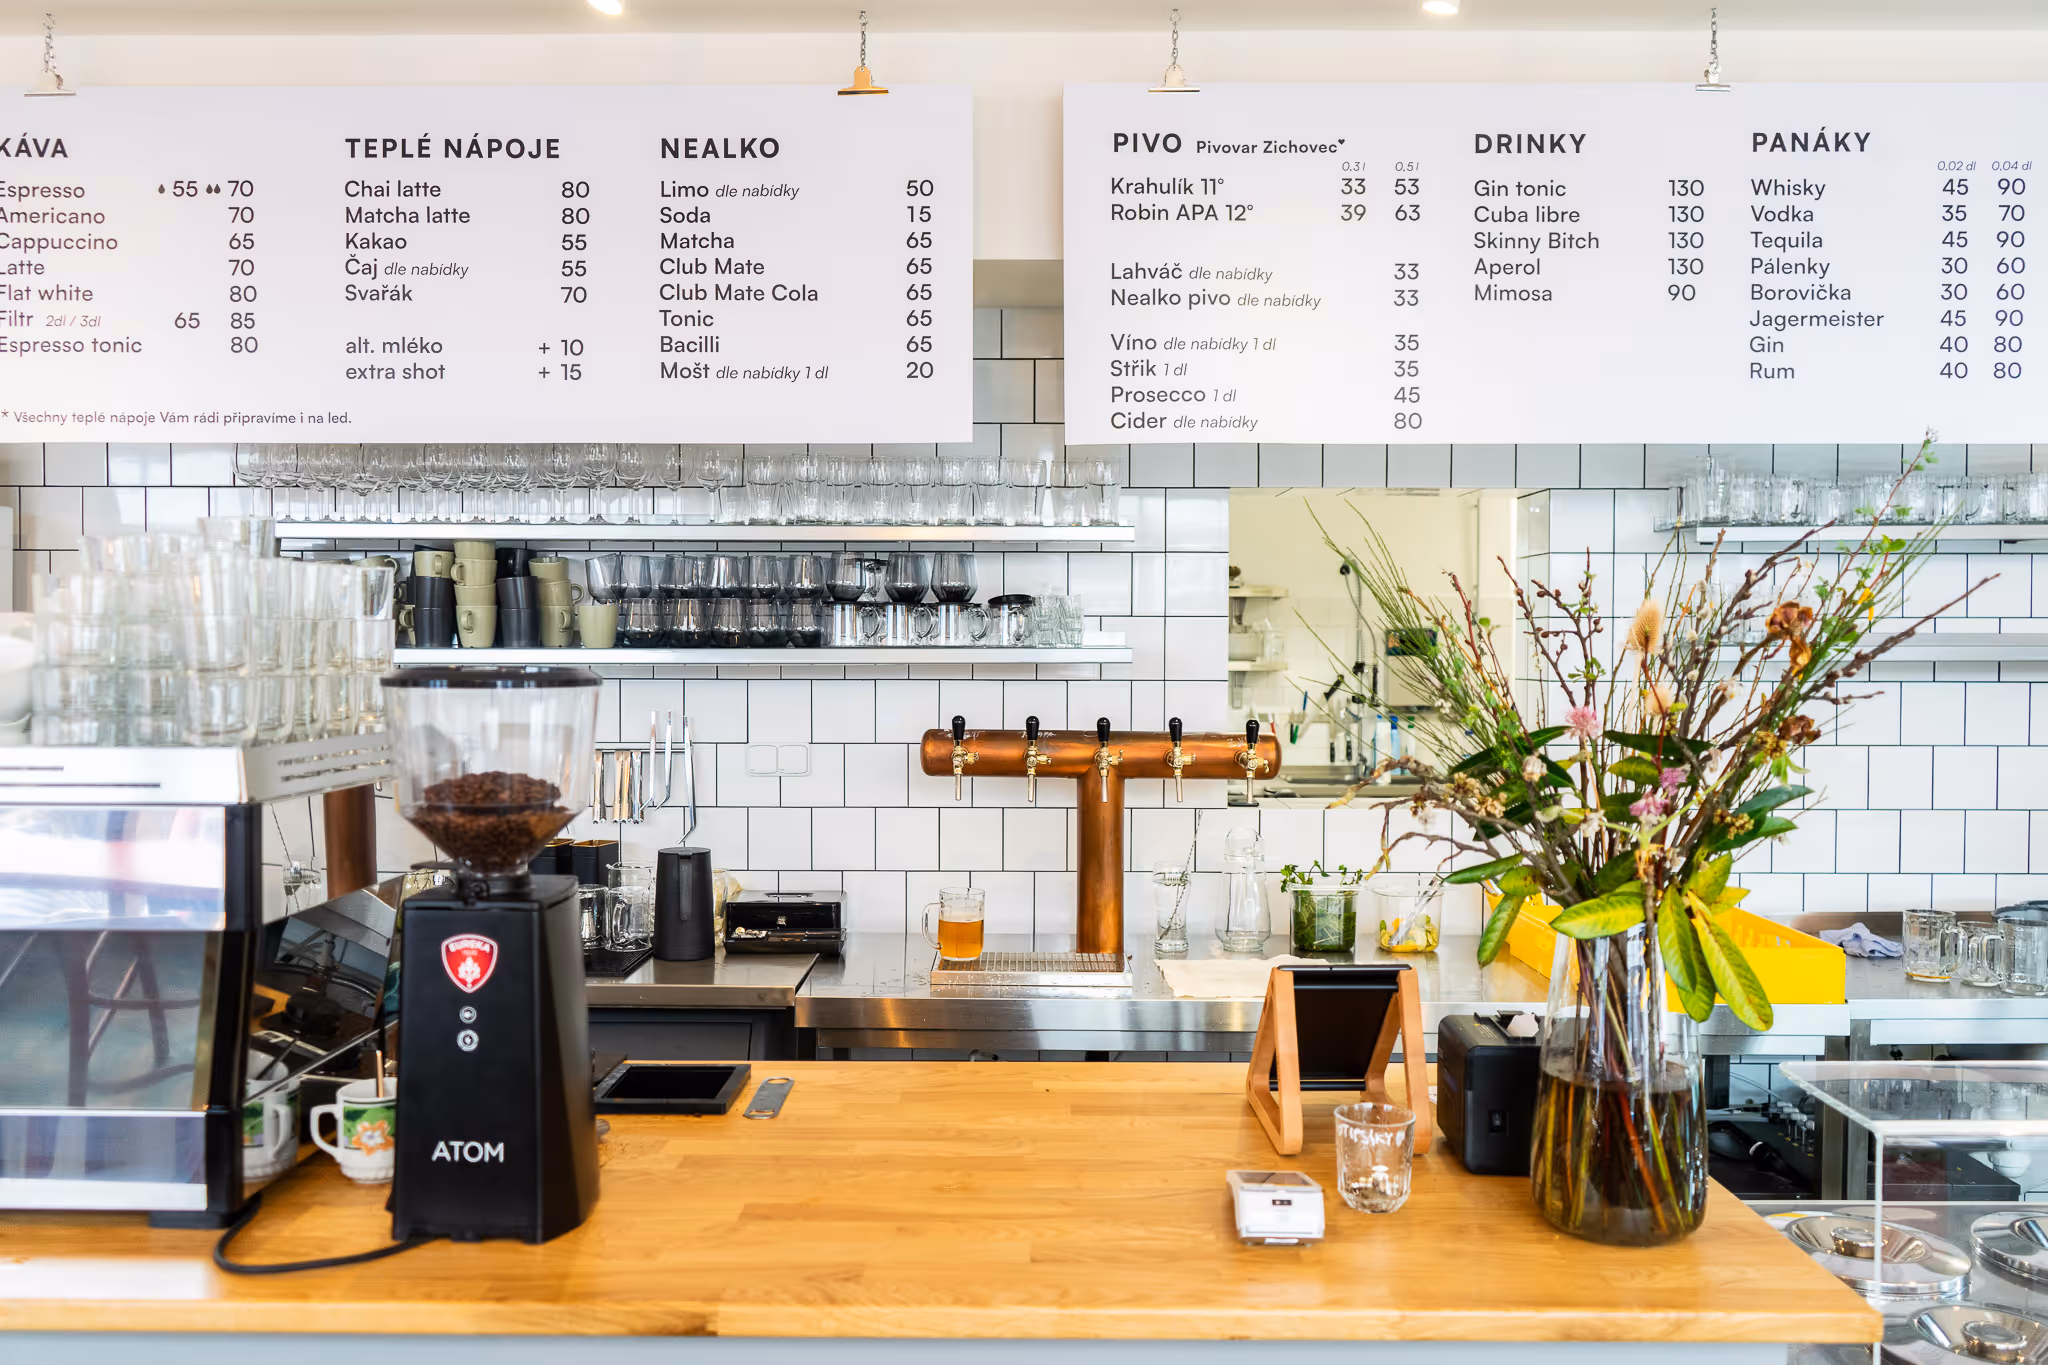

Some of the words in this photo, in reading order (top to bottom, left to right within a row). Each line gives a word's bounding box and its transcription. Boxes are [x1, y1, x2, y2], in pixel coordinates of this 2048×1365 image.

[345, 133, 431, 158] TEPLÉ
[444, 133, 559, 159] NÁPOJE
[1114, 133, 1181, 153] PIVO
[1197, 141, 1257, 153] Pivovar
[1263, 140, 1337, 153] Zichovec
[1475, 134, 1586, 154] DRINKY
[1753, 126, 1870, 152] PANÁKY
[661, 138, 779, 159] NEALKO
[173, 181, 198, 197] 55
[227, 180, 254, 197] 70
[345, 180, 390, 197] Chai
[398, 180, 441, 197] latte
[562, 181, 589, 198] 80
[661, 181, 709, 197] Limo
[716, 184, 737, 197] dle
[742, 184, 800, 200] nabídky
[907, 180, 934, 196] 50
[1112, 177, 1193, 194] Krahulík
[1341, 178, 1366, 195] 33
[1394, 178, 1419, 195] 53
[1474, 180, 1508, 196] Gin
[1516, 180, 1566, 196] tonic
[1669, 179, 1704, 196] 130
[1751, 179, 1826, 200] Whisky
[1942, 179, 1968, 195] 45
[1998, 178, 2025, 195] 90
[228, 206, 254, 223] 70
[346, 206, 419, 223] Matcha
[427, 206, 470, 223] latte
[562, 208, 590, 224] 80
[660, 206, 710, 223] Soda
[907, 206, 931, 222] 15
[1112, 203, 1168, 220] Robin
[1176, 204, 1219, 221] APA
[1341, 204, 1366, 221] 39
[1395, 204, 1420, 221] 63
[1474, 206, 1528, 222] Cuba
[1536, 206, 1580, 223] libre
[1668, 206, 1704, 222] 130
[1751, 205, 1813, 222] Vodka
[1942, 204, 1967, 221] 35
[1999, 205, 2025, 221] 70
[229, 233, 254, 250] 65
[346, 232, 407, 249] Kakao
[562, 234, 587, 251] 55
[661, 232, 734, 249] Matcha
[906, 232, 932, 249] 65
[1474, 232, 1541, 254] Skinny
[1549, 232, 1599, 249] Bitch
[1668, 232, 1704, 249] 130
[1750, 231, 1822, 253] Tequila
[1942, 231, 1968, 248] 45
[1997, 231, 2025, 248] 90
[228, 259, 254, 276] 70
[345, 254, 377, 280] Čaj
[384, 262, 406, 275] dle
[411, 263, 469, 279] nabídky
[561, 260, 586, 277] 55
[660, 258, 707, 275] Club
[715, 258, 764, 275] Mate
[907, 258, 932, 274] 65
[1112, 262, 1182, 279] Lahváč
[1189, 266, 1211, 279] dle
[1216, 267, 1273, 284] nabídky
[1394, 263, 1419, 280] 33
[1474, 258, 1540, 280] Aperol
[1668, 258, 1704, 275] 130
[1752, 257, 1830, 279] Pálenky
[1941, 257, 1968, 274] 30
[1997, 257, 2025, 274] 60
[38, 284, 93, 301] white
[230, 285, 257, 302] 80
[345, 284, 412, 301] Svařák
[561, 286, 587, 303] 70
[660, 283, 707, 300] Club
[715, 284, 764, 301] Mate
[772, 284, 818, 301] Cola
[907, 284, 932, 301] 65
[1112, 288, 1181, 306] Nealko
[1189, 289, 1230, 310] pivo
[1238, 293, 1259, 306] dle
[1264, 294, 1321, 310] nabídky
[1394, 290, 1418, 306] 33
[1475, 284, 1552, 301] Mimosa
[1668, 284, 1696, 301] 90
[1751, 283, 1851, 300] Borovička
[1941, 283, 1967, 300] 30
[1996, 283, 2025, 300] 60
[46, 315, 66, 326] 2dl
[80, 316, 101, 327] 3dl
[174, 312, 200, 329] 65
[231, 312, 255, 329] 85
[659, 310, 714, 327] Tonic
[907, 310, 932, 327] 65
[1750, 310, 1884, 332] Jagermeister
[1940, 310, 1966, 326] 45
[1995, 310, 2023, 326] 90
[0, 336, 84, 357] Espresso
[91, 336, 142, 353] tonic
[231, 336, 258, 353] 80
[346, 337, 374, 353] alt.
[383, 337, 442, 353] mléko
[561, 339, 584, 356] 10
[661, 336, 719, 353] Bacilli
[907, 336, 932, 352] 65
[1110, 334, 1157, 350] Víno
[1164, 337, 1185, 350] dle
[1191, 337, 1248, 353] nabídky
[1394, 334, 1419, 351] 35
[1750, 336, 1784, 353] Gin
[1940, 336, 1968, 352] 40
[1994, 336, 2022, 352] 80
[346, 364, 395, 379] extra
[402, 362, 445, 379] shot
[561, 364, 581, 380] 15
[661, 362, 710, 379] Mošt
[716, 366, 738, 379] dle
[743, 366, 800, 382] nabídky
[907, 362, 933, 378] 20
[1111, 359, 1156, 377] Střik
[1394, 361, 1419, 377] 35
[1750, 362, 1794, 379] Rum
[1940, 362, 1968, 379] 40
[1994, 362, 2022, 379] 80
[1112, 386, 1206, 403] Prosecco
[1394, 387, 1420, 403] 45
[14, 411, 67, 425] Všechny
[72, 411, 105, 425] teplé
[111, 412, 155, 426] nápoje
[160, 412, 189, 423] Vám
[194, 412, 219, 423] rádi
[224, 413, 296, 426] připravíme
[308, 415, 323, 423] na
[328, 412, 351, 423] led.
[1111, 412, 1167, 429] Cider
[1174, 415, 1195, 428] dle
[1201, 415, 1258, 431] nabídky
[1394, 412, 1422, 429] 80
[432, 1141, 504, 1163] ATOM
